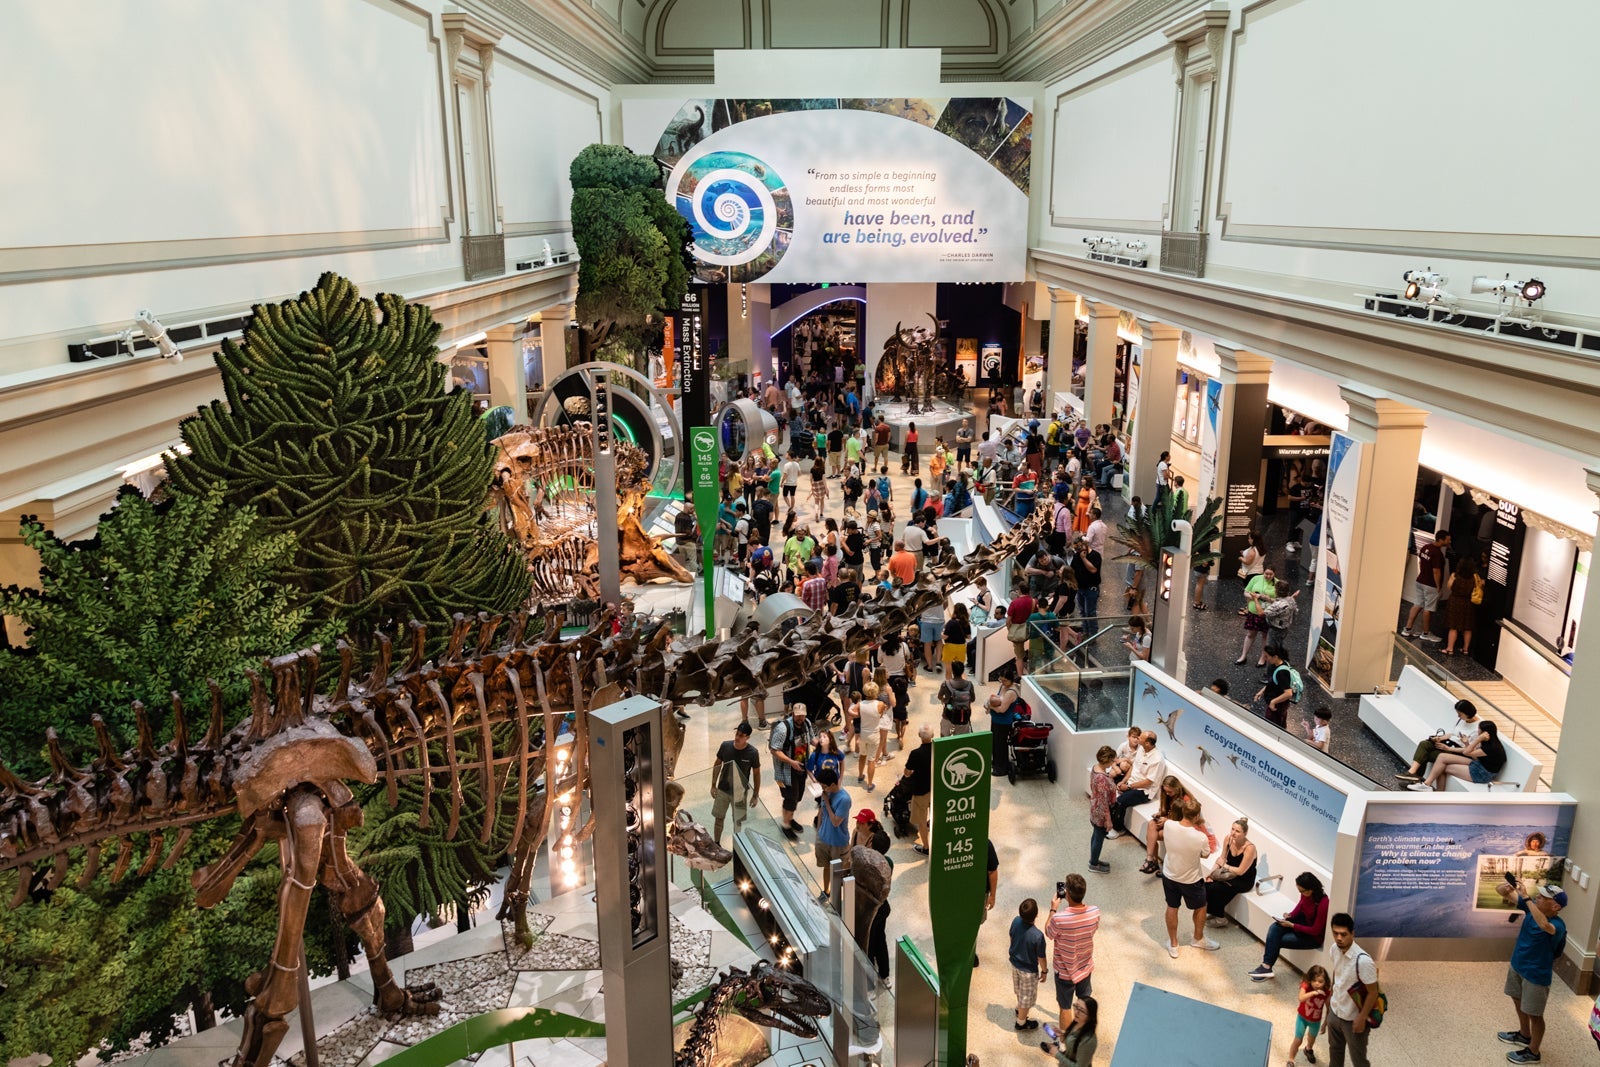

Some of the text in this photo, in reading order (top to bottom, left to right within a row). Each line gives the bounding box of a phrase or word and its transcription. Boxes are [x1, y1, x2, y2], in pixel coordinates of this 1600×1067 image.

[852, 171, 881, 181] simple
[892, 171, 936, 182] beginning
[830, 184, 914, 194] endless forms most
[806, 196, 846, 207] beautiful
[847, 197, 865, 205] and
[891, 196, 936, 207] wonderful
[844, 210, 975, 227] have been, and
[823, 228, 988, 247] are being, evolved.”
[684, 294, 697, 302] 66
[682, 318, 693, 393] Mass Extinction
[1497, 510, 1517, 524] MILLION
[1204, 724, 1319, 800] Ecosystems change as the
[1240, 759, 1339, 825] Earth changes and life evolves.
[946, 796, 975, 814] 201
[945, 812, 976, 823] MILLION
[953, 826, 966, 835] TO
[945, 838, 973, 855] 145
[944, 854, 974, 865] MILLION
[1380, 850, 1399, 858] Why
[1442, 850, 1472, 859] change
[944, 863, 961, 872] YEARS
